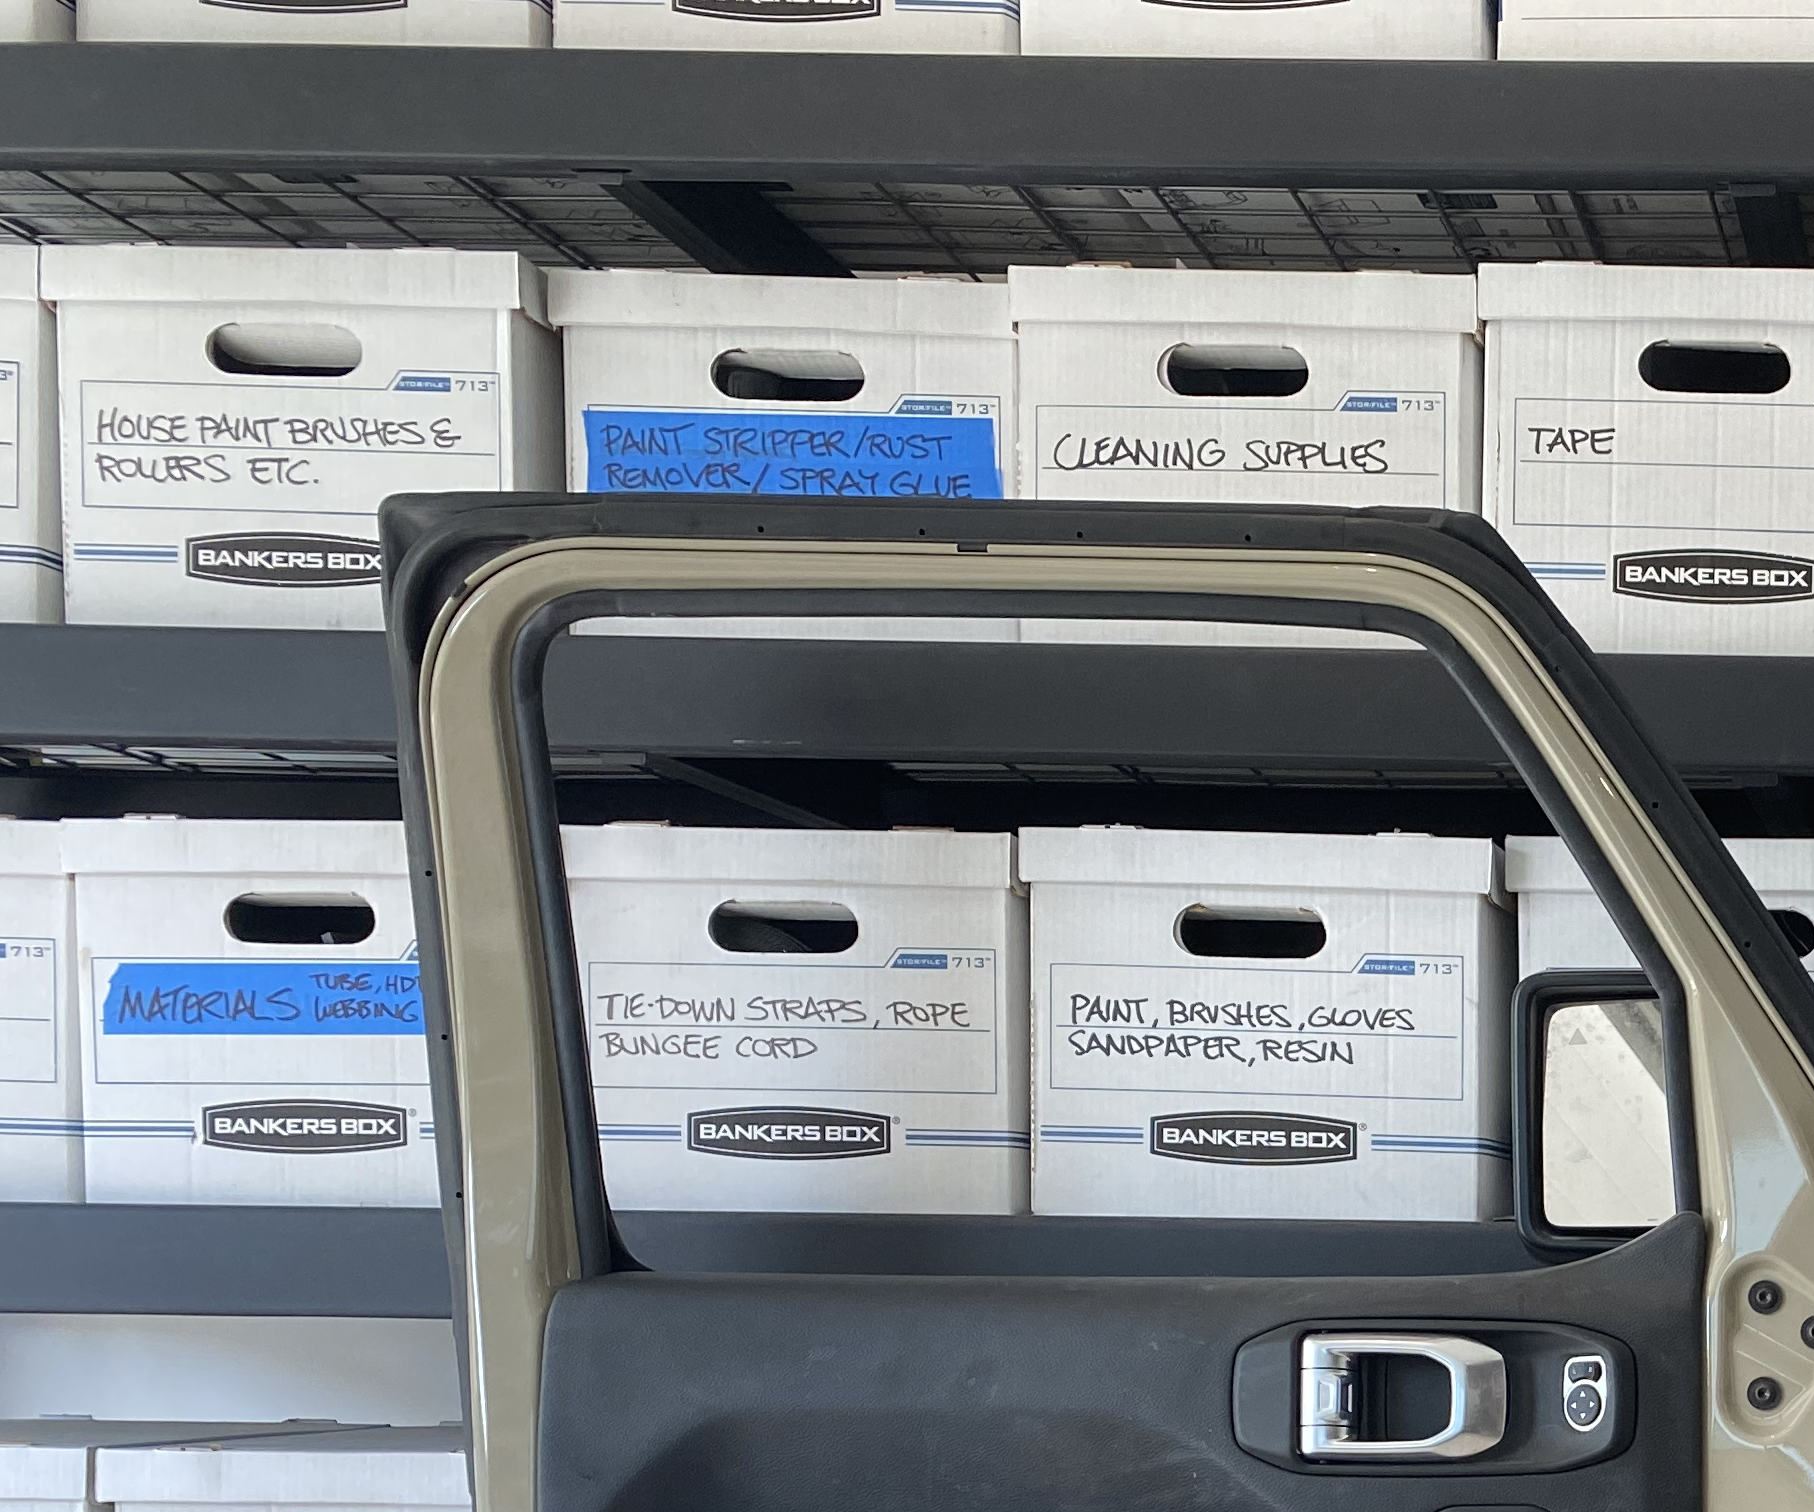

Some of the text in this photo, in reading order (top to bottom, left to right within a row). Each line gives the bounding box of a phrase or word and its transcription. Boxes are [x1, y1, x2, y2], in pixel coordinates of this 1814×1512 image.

[98, 407, 189, 443] HOUSE
[196, 413, 280, 448] PAINT
[284, 416, 426, 448] BRUSHES
[601, 422, 696, 456] PAINT
[1528, 426, 1616, 455] TAPE
[1053, 433, 1390, 474] CLEANING SUPPLIES
[95, 453, 320, 485] ROLLERS ETC.
[779, 469, 880, 498] SPRAY
[888, 471, 973, 499] GLUE
[197, 549, 381, 570] BANKERS BOX
[1625, 565, 1809, 587] BANKERS BOX
[385, 974, 421, 995] HD
[118, 984, 302, 1025] MATERIALS
[314, 996, 419, 1023] WEBBING
[596, 992, 736, 1022] TIE-DOWN
[886, 1001, 971, 1028] ROPE
[1307, 1006, 1415, 1031] GLOVES
[598, 1032, 818, 1059] BUNGEE CORD
[1256, 1038, 1354, 1065] RESIN
[214, 1117, 397, 1136] BANKERS BOX
[699, 1123, 881, 1143] BANKERS BOX
[1162, 1127, 1347, 1149] BANKERS BOX
